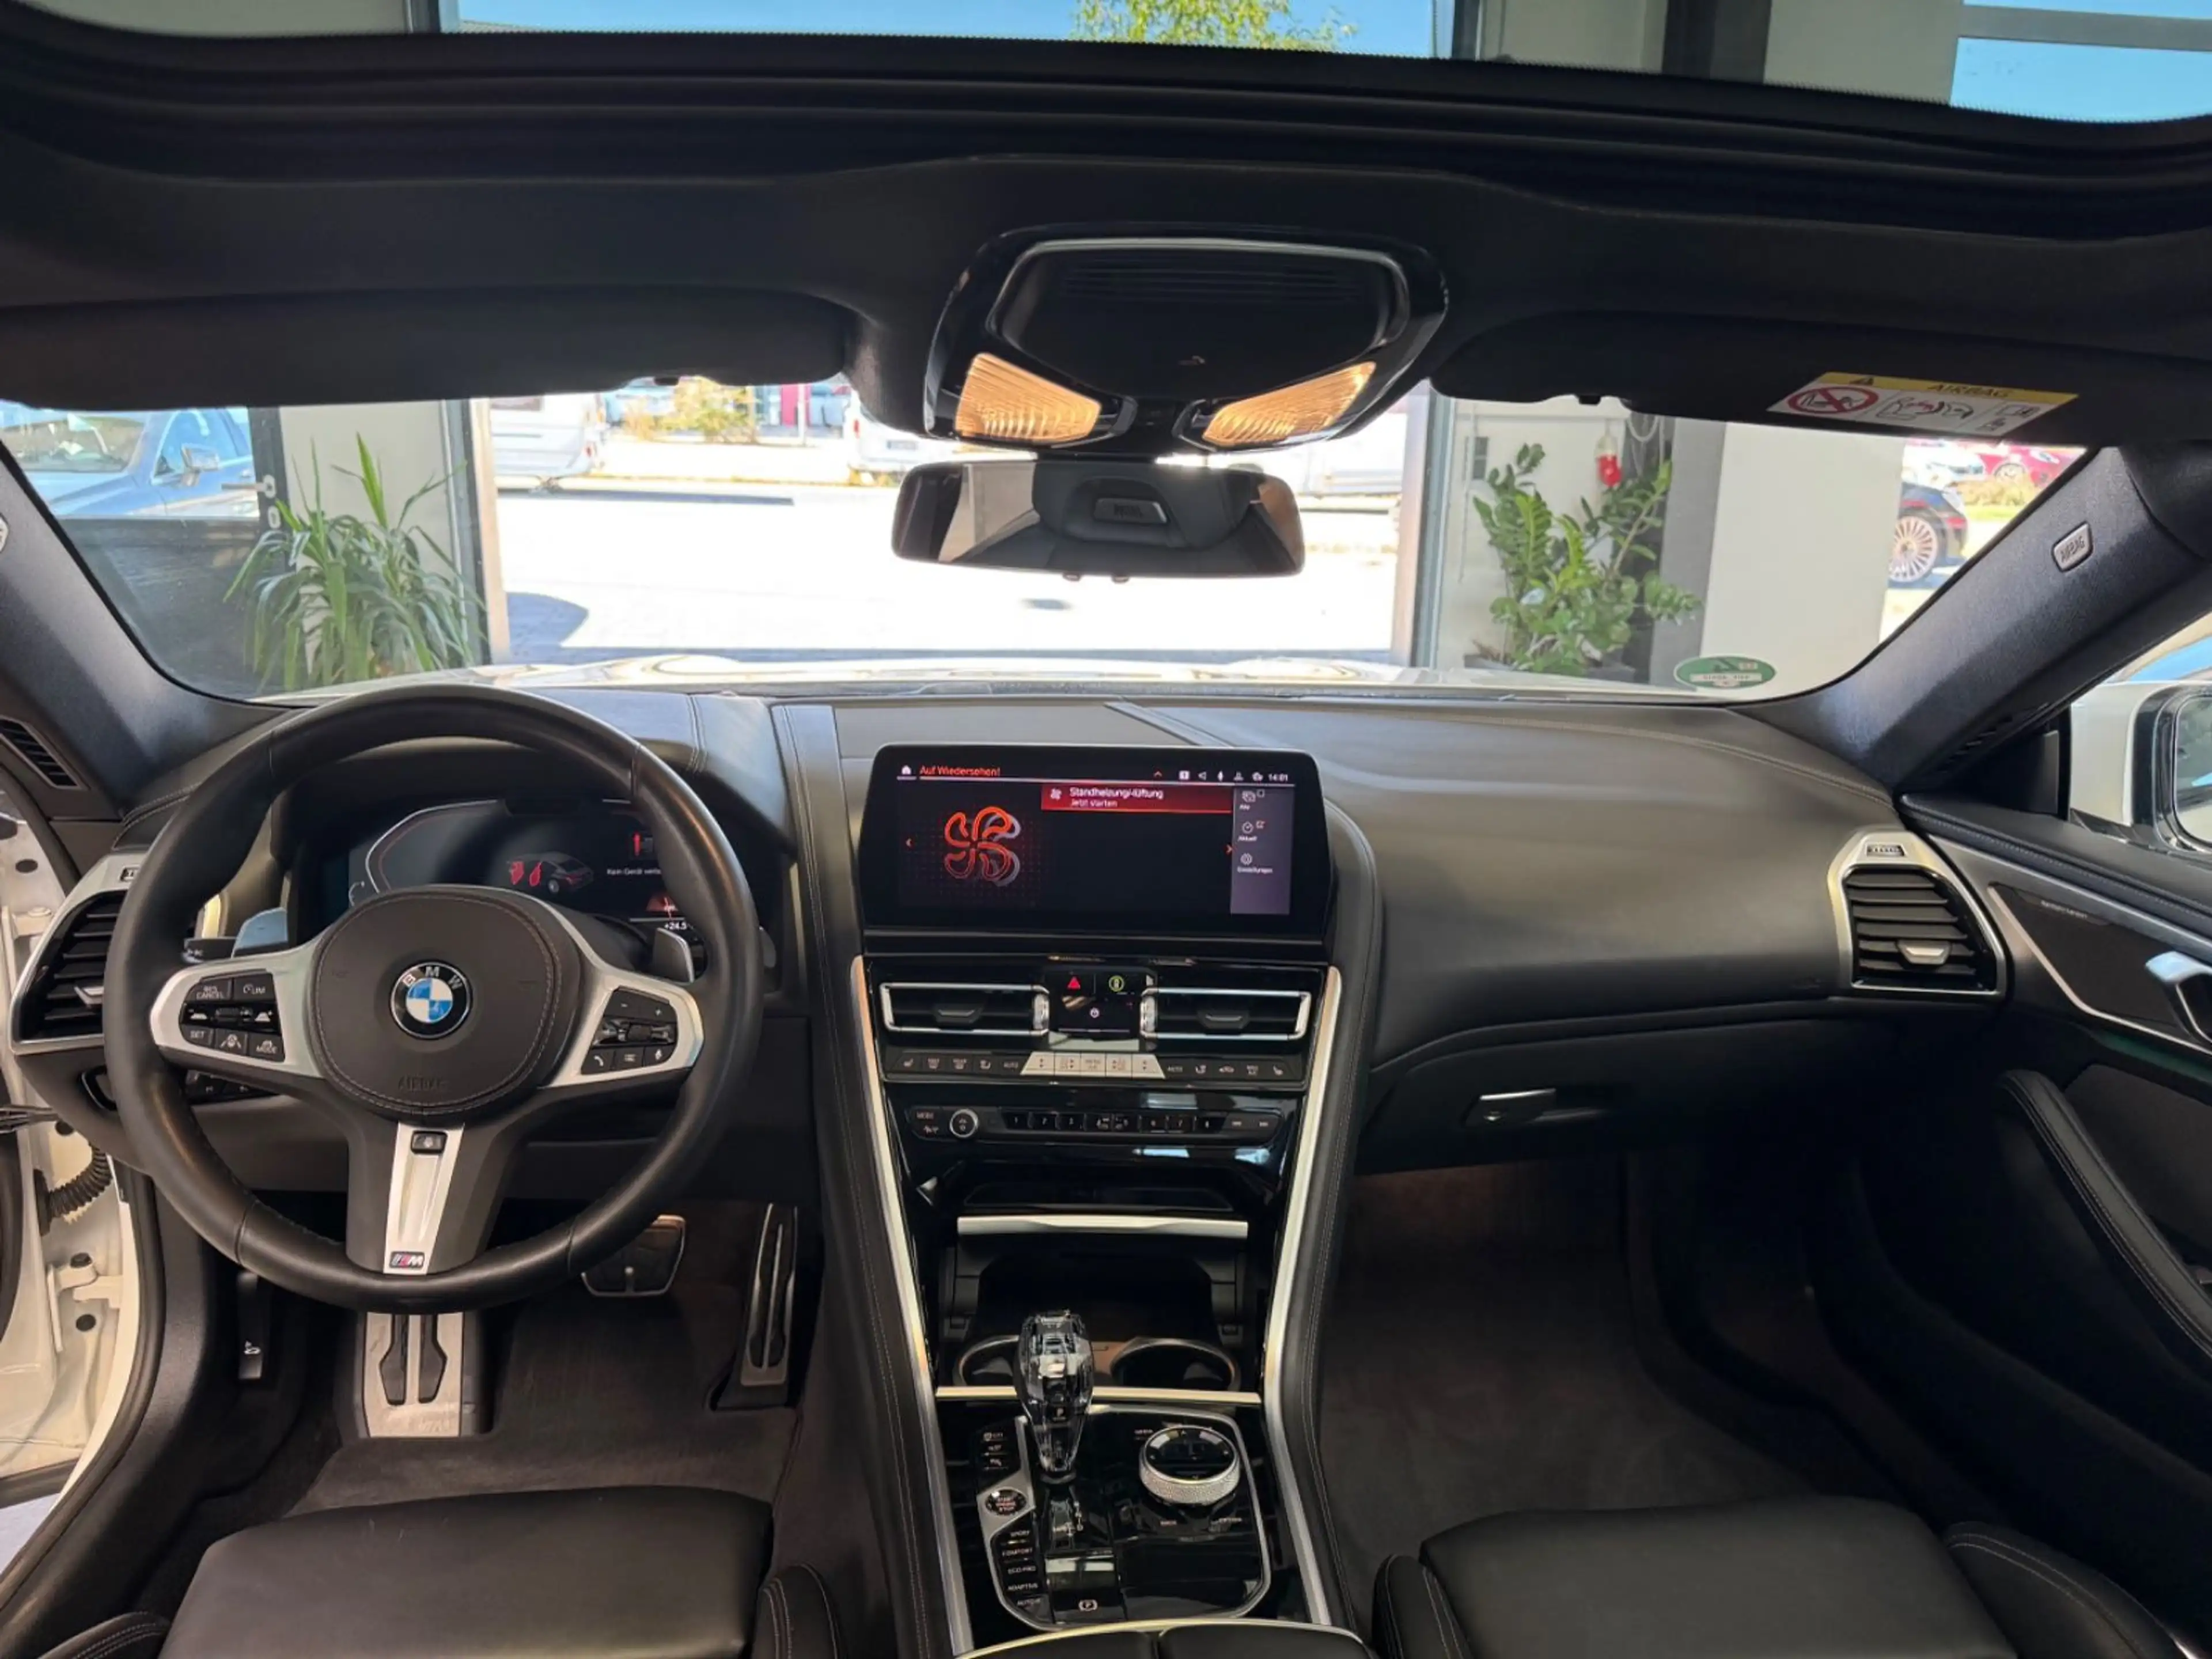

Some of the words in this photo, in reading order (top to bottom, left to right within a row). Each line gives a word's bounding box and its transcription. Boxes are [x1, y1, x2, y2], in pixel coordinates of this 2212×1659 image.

[1927, 384, 2009, 398] AIRBAG
[2061, 536, 2085, 563] AIRBAG
[920, 766, 936, 775] Auf
[937, 766, 1001, 776] Wiedersehen!
[403, 966, 463, 990] BMW
